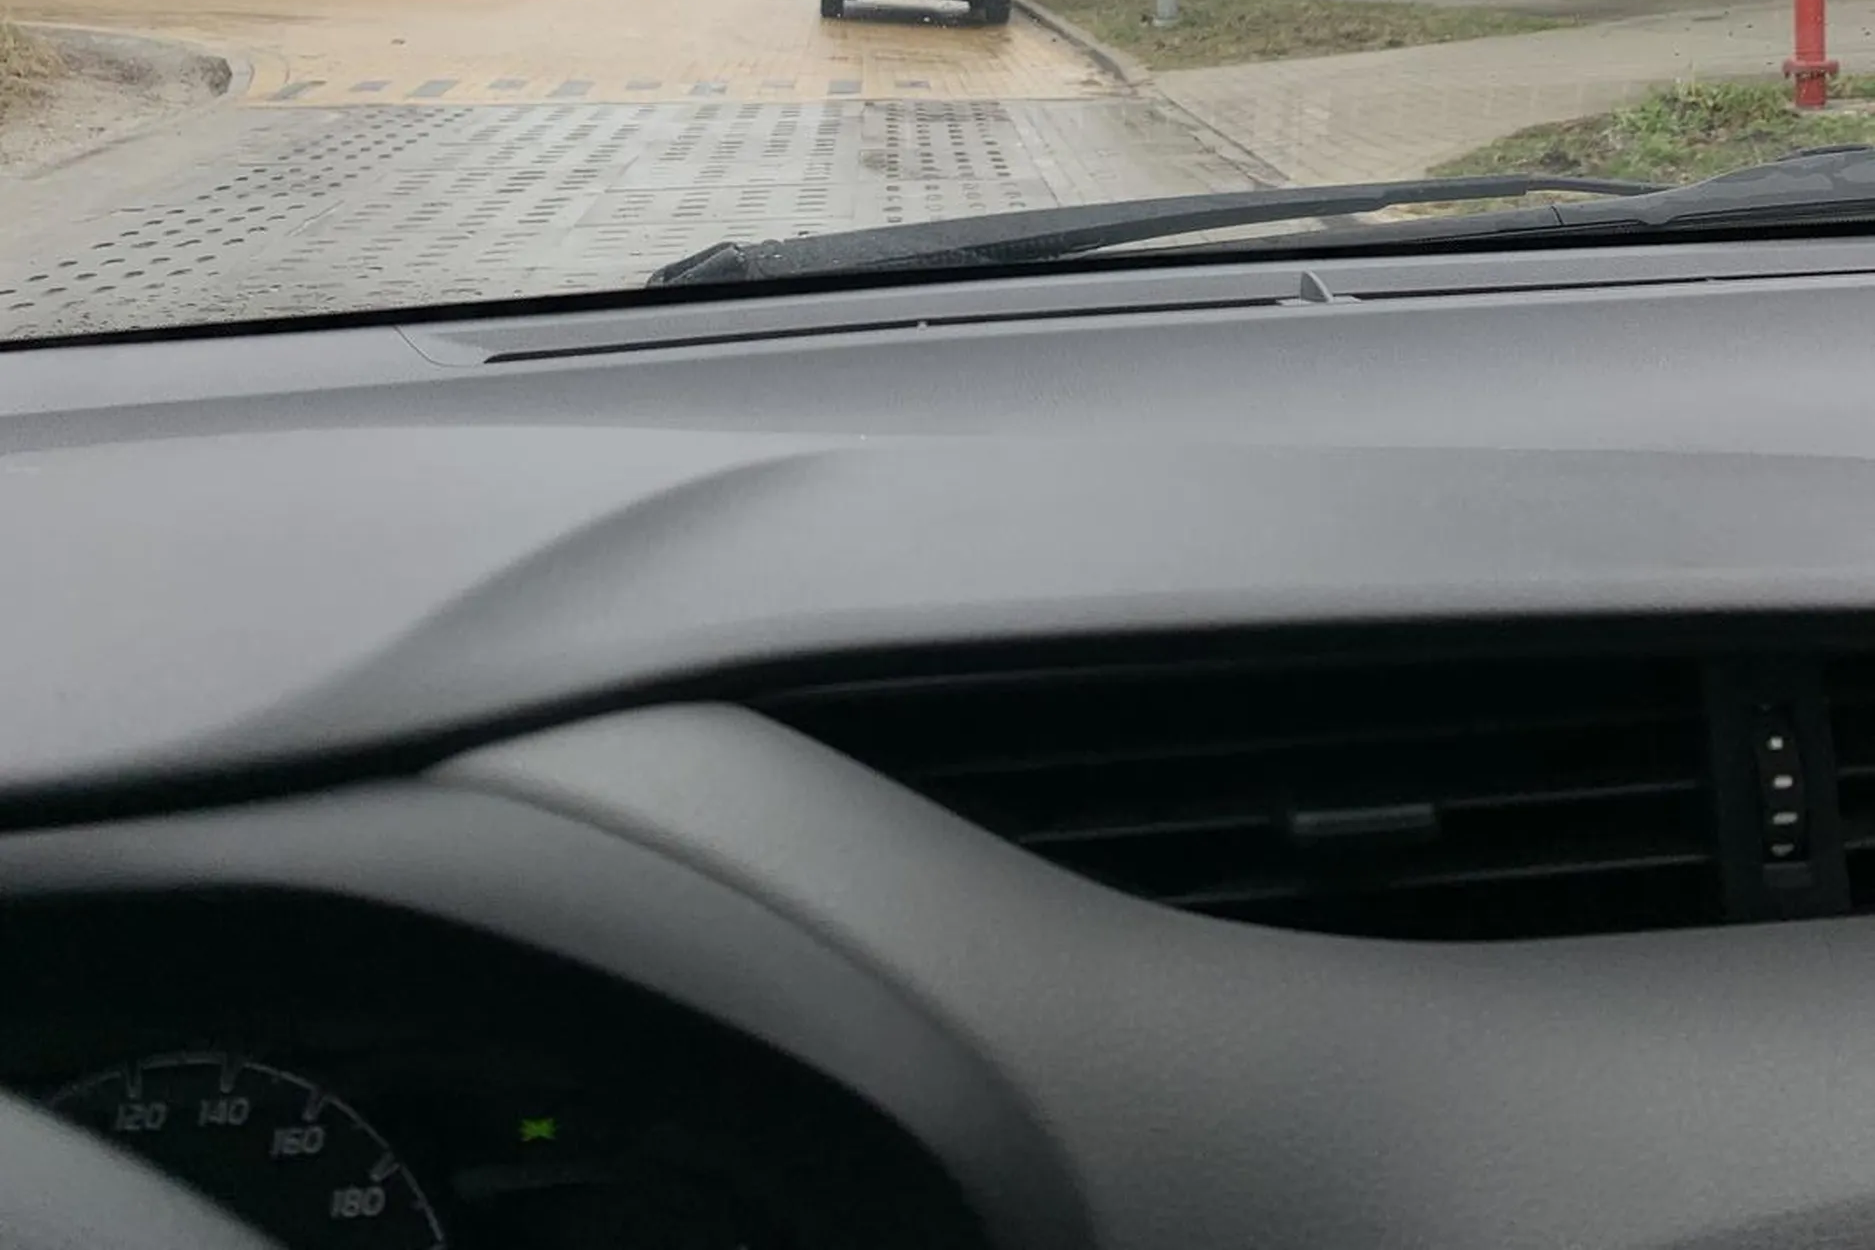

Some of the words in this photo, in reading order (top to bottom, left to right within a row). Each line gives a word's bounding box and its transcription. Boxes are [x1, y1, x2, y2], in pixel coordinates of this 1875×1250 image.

[115, 1102, 169, 1131] 120
[198, 1096, 250, 1128] 140
[270, 1125, 326, 1157] 160
[330, 1186, 387, 1219] 180
